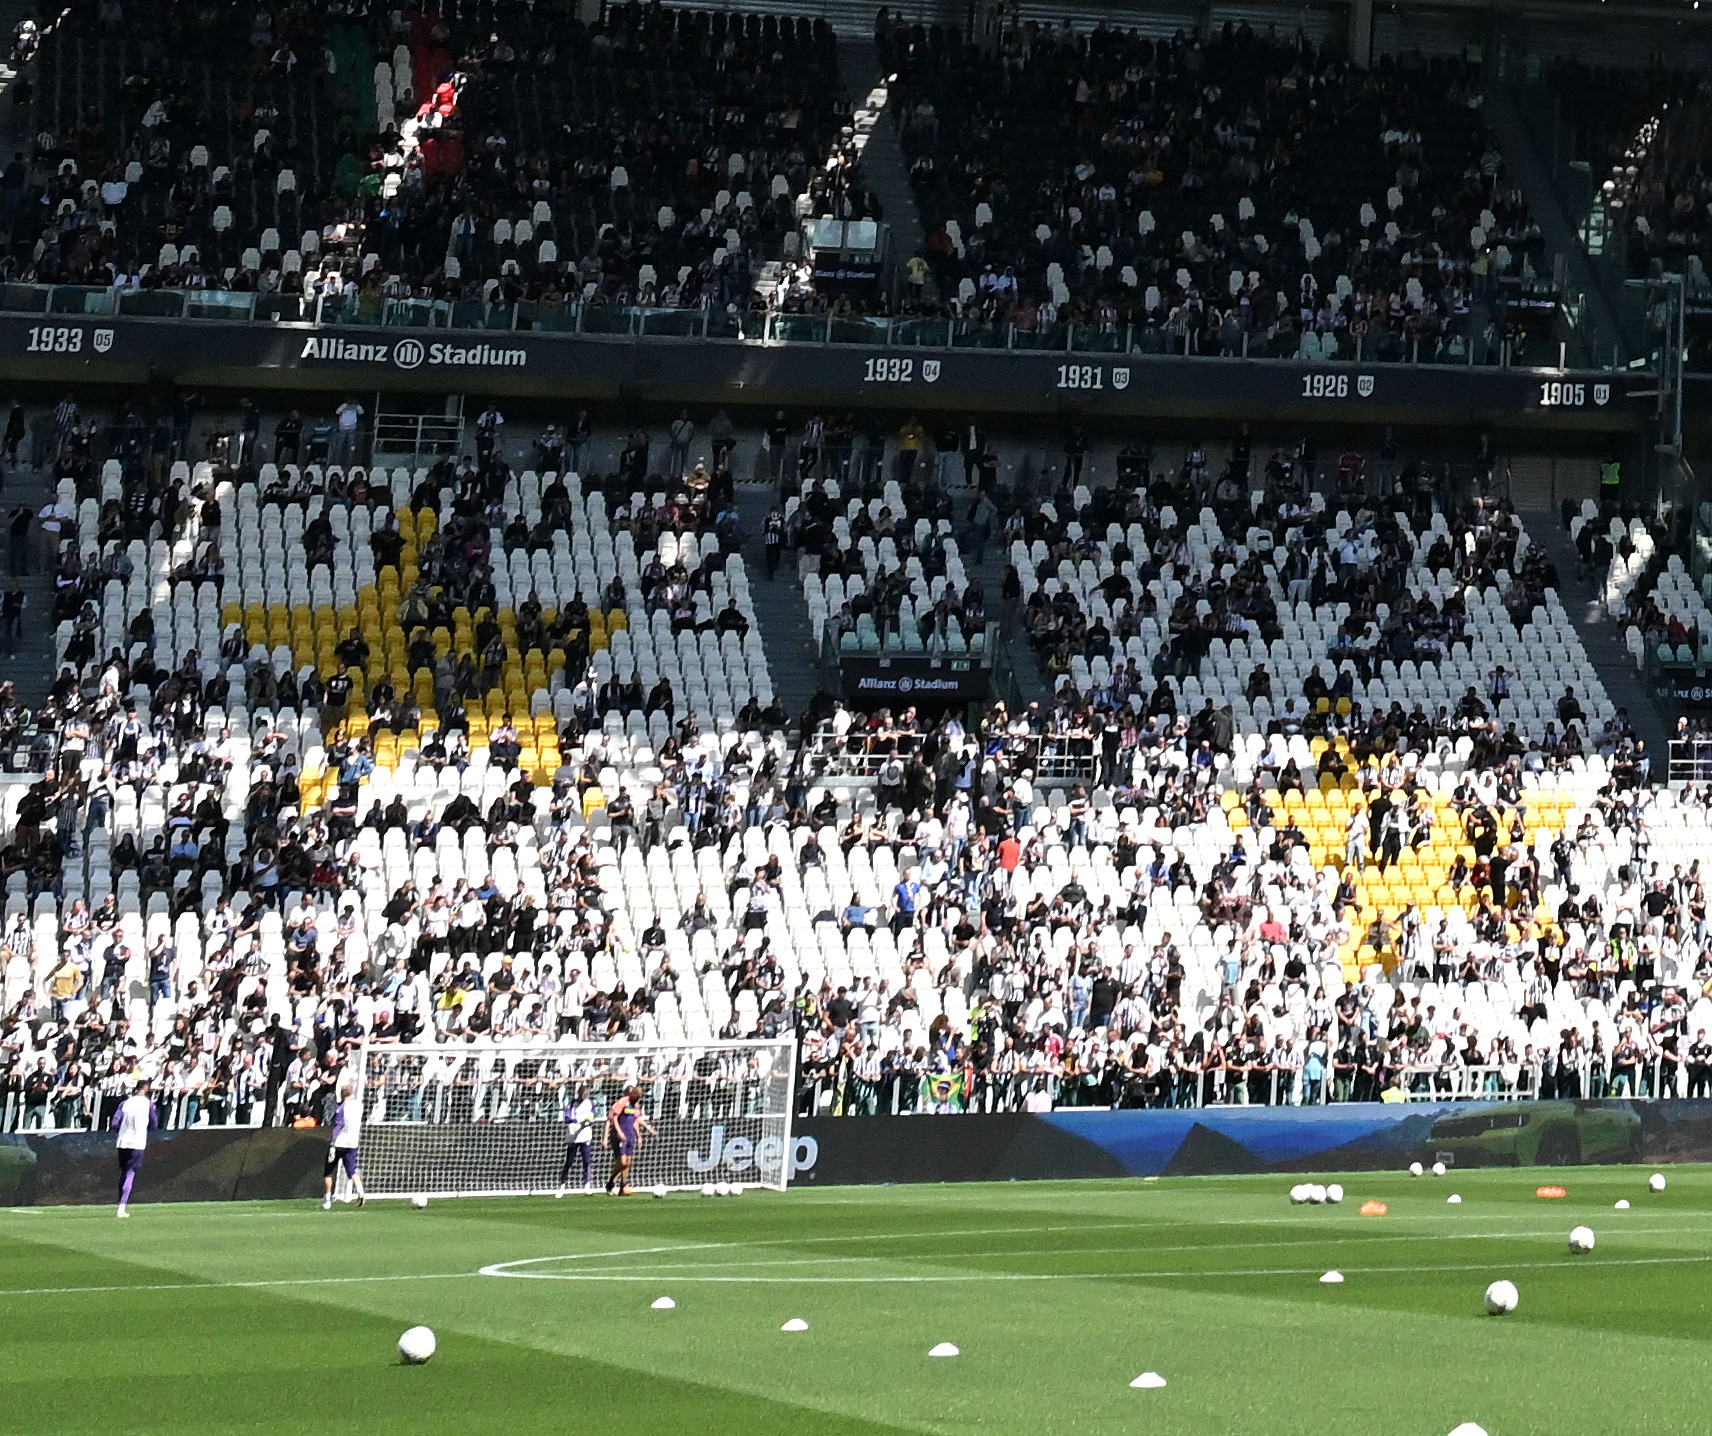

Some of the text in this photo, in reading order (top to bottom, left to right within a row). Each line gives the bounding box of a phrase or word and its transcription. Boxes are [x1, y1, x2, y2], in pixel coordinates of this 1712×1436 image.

[25, 326, 83, 353] 1933
[301, 337, 527, 367] Allianz Stadium
[863, 358, 913, 382] 1932
[1056, 364, 1103, 389] 1931
[1301, 374, 1348, 397] 1926
[1539, 382, 1585, 406] 1905
[857, 678, 959, 690] Allianz Stadium
[688, 1125, 819, 1181] Jeep
